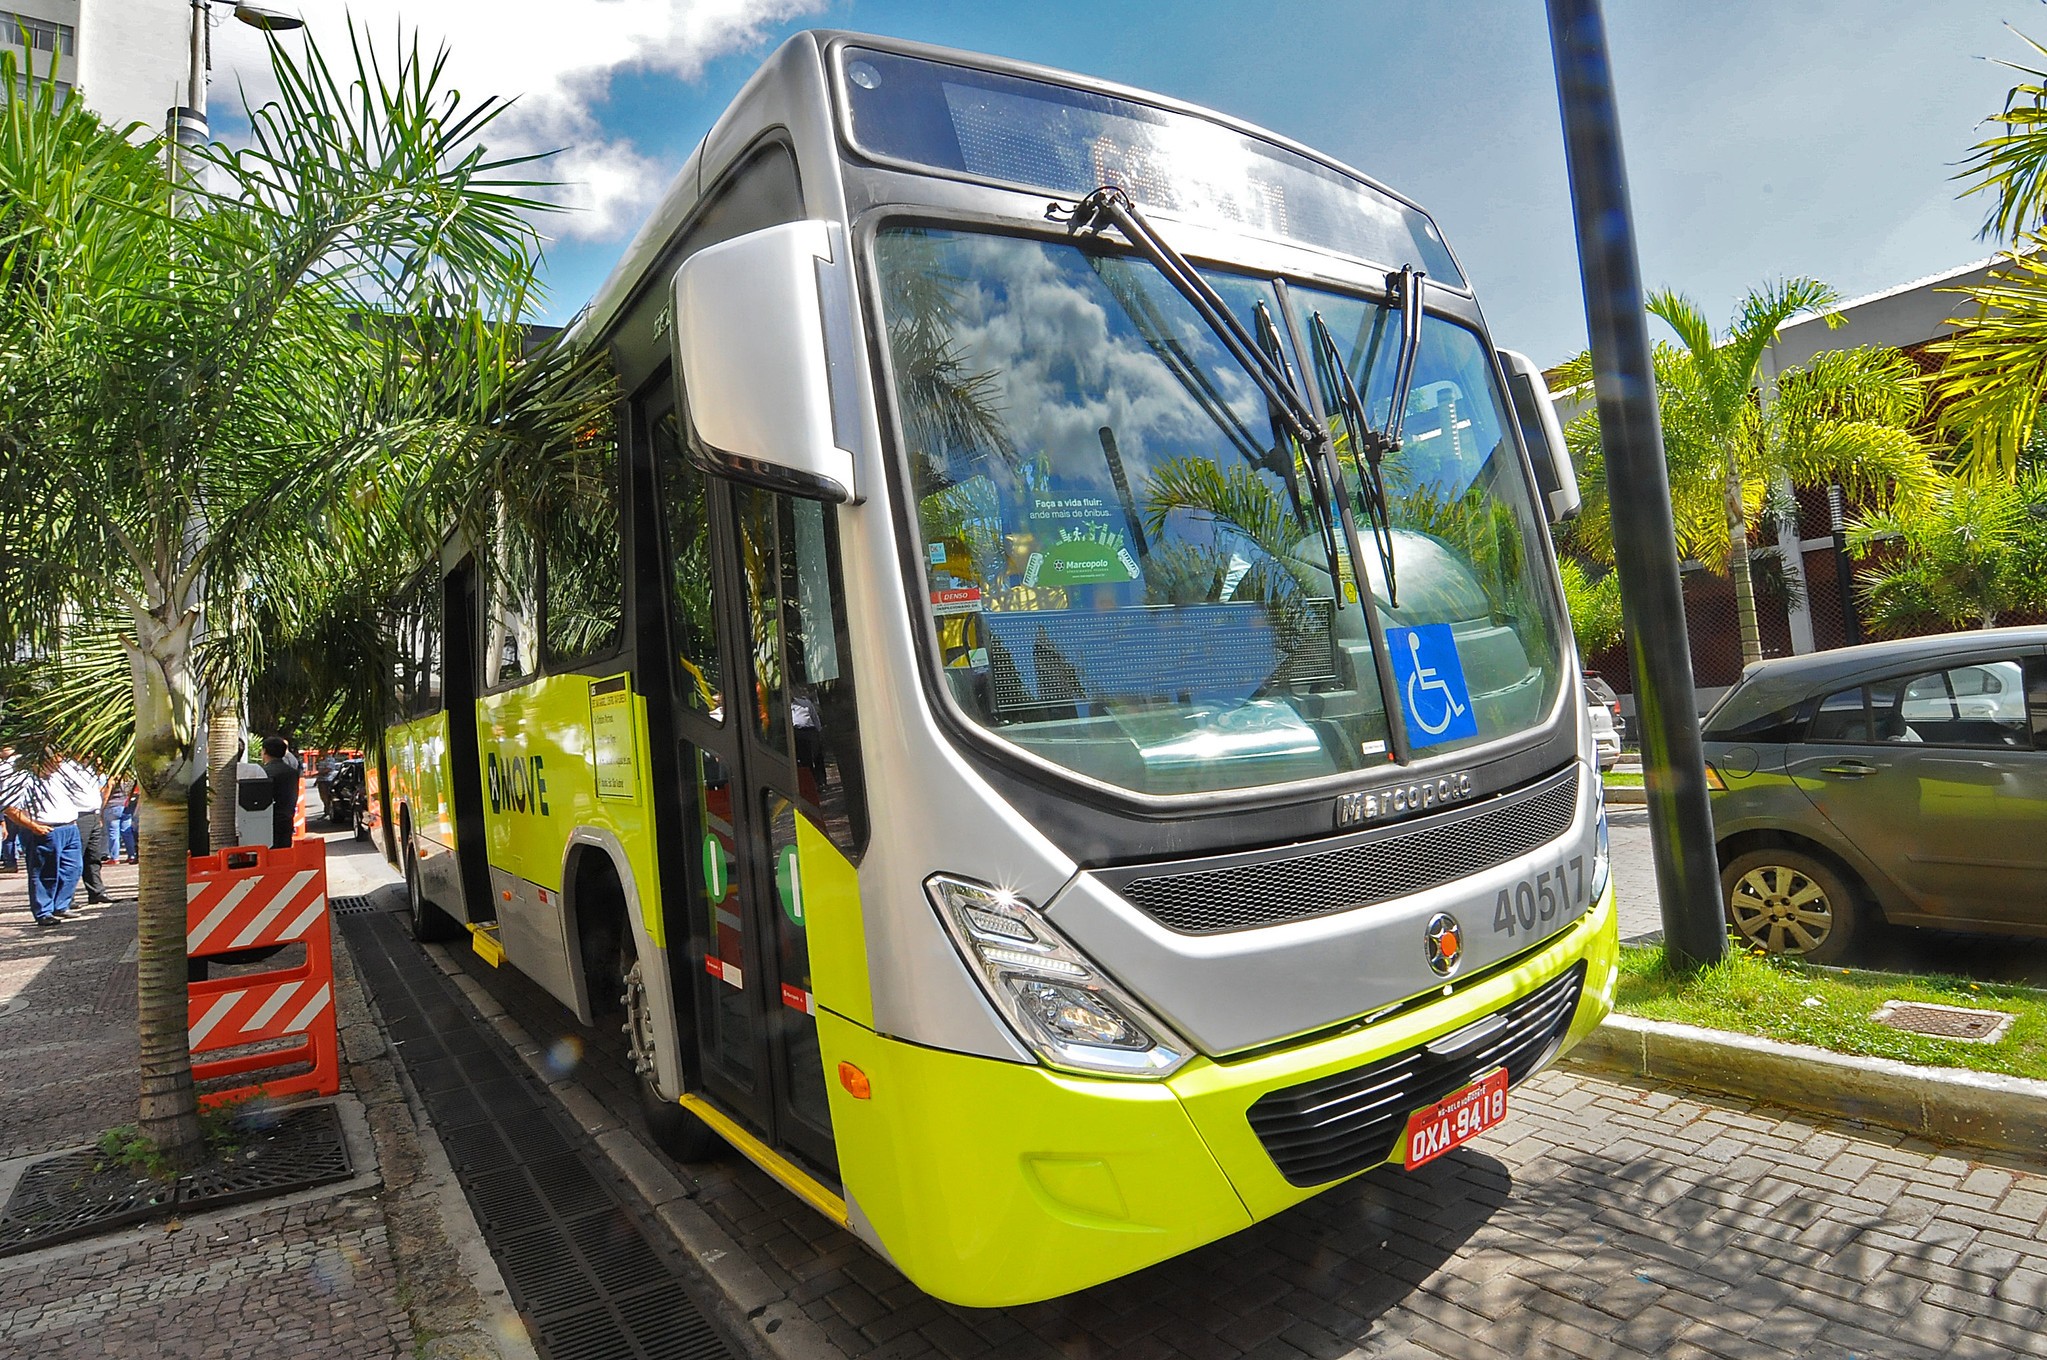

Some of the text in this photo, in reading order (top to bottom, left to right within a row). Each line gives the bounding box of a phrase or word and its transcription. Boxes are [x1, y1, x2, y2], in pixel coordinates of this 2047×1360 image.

[1035, 500, 1056, 509] Faça
[1064, 499, 1082, 507] vida
[1083, 498, 1103, 507] fluir:
[1030, 508, 1112, 519] ande mais de ônibus.
[1066, 559, 1108, 569] Marcopolo
[943, 592, 969, 600] DENSO
[500, 756, 549, 816] MOVE
[1342, 773, 1472, 823] Marcopolo
[1493, 855, 1583, 938] 40517
